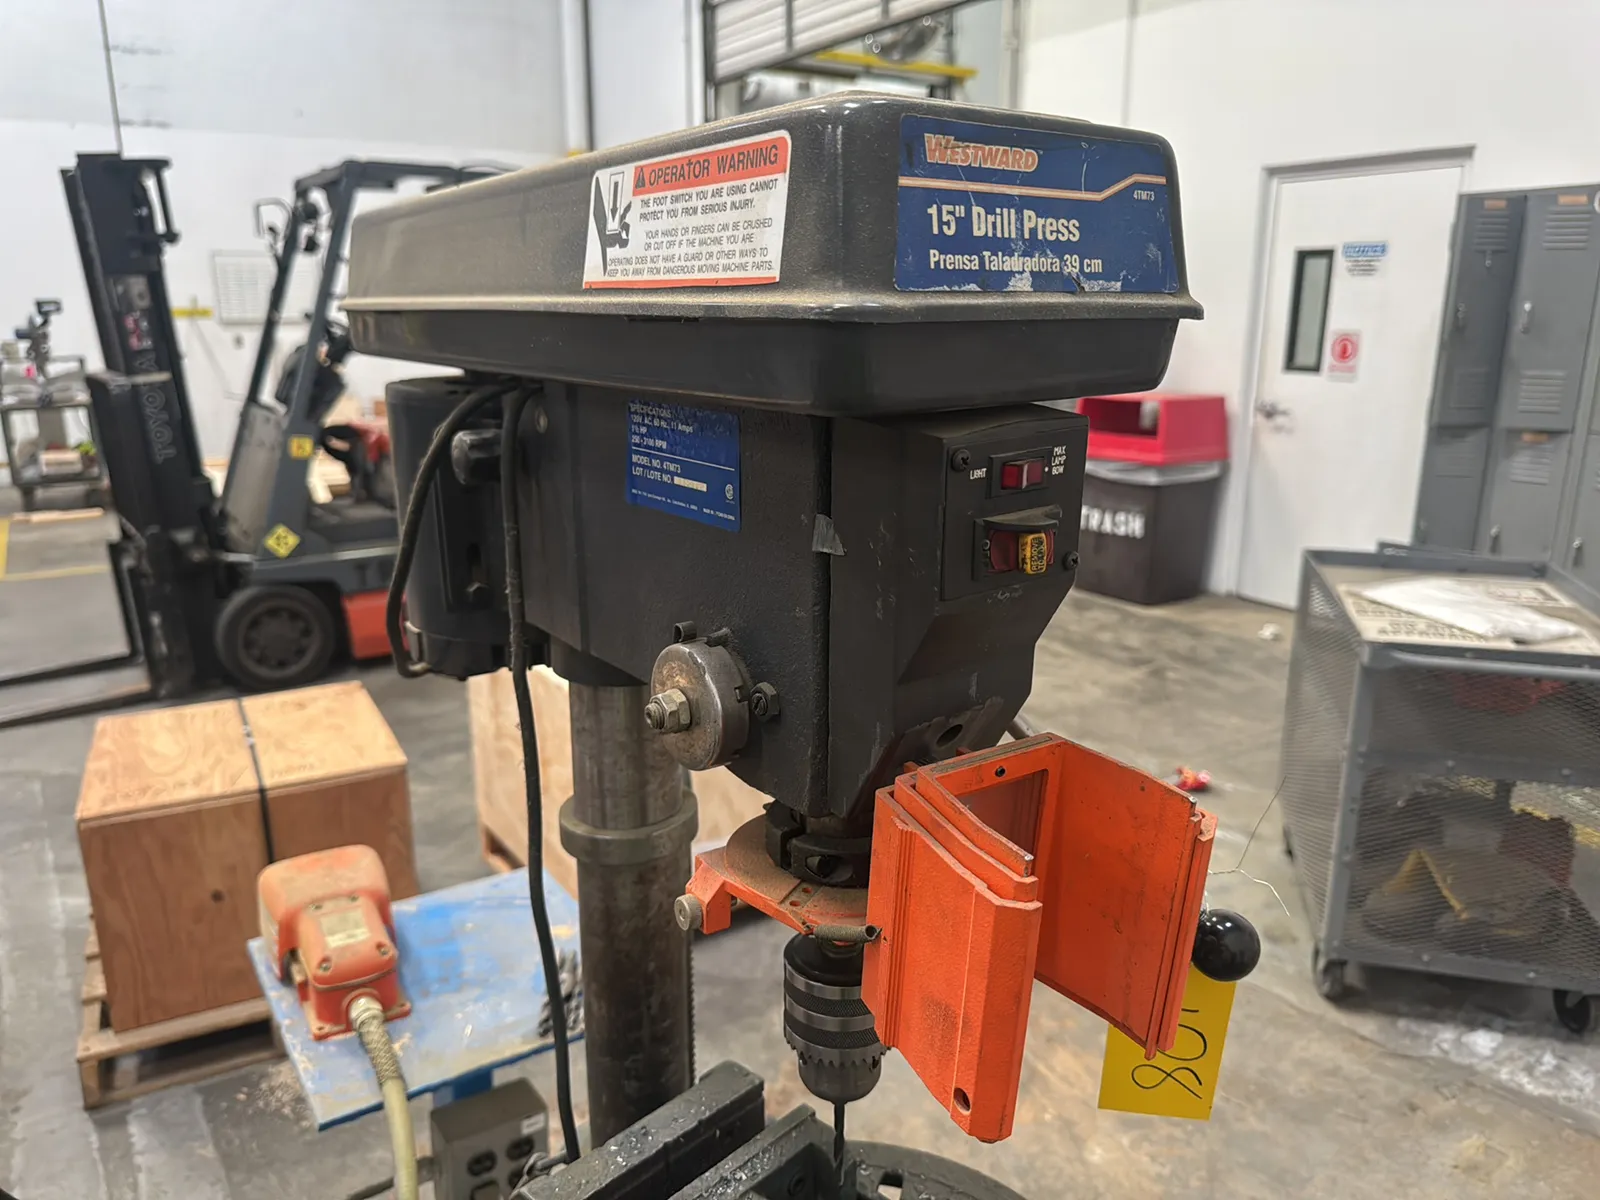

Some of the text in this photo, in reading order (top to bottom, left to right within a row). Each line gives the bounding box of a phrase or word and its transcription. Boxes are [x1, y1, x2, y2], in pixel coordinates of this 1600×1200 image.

[924, 133, 1038, 172] WESTWARD
[650, 145, 778, 186] OPERATOR WARNING
[641, 179, 778, 208] THE FOOT SWITCH YOU ARE USING CANNOT
[1133, 189, 1155, 201] 4TM73
[640, 199, 756, 222] PROTECT YOU FROM SERIOUS INJURY.
[646, 218, 772, 239] YOUR HANDS OR FINGERS CAN BE CRUSHED
[927, 204, 1080, 242] 15" Drill Press
[644, 234, 754, 251] OR CUT OFF IF THE MACHINE YOU ARE
[608, 256, 633, 267] OPERATING
[634, 256, 648, 265] DOES
[650, 255, 660, 263] NOT
[662, 254, 675, 263] HAVE
[684, 252, 703, 261] GUARD
[705, 251, 714, 260] OR
[716, 249, 736, 260] OTHER
[739, 248, 756, 258] WAYS
[758, 248, 768, 256] TO
[929, 249, 1102, 273] Prensa Taladradora 39 cm
[608, 260, 774, 277] KEEP YOU AWAY FROM DANGEROUS MOVING MACHINE PARTS.
[134, 352, 177, 464] TOYOA
[632, 454, 651, 466] MODEL
[1052, 456, 1066, 466] LAMP
[1054, 446, 1066, 455] MAX
[970, 468, 987, 479] LIGHT
[1080, 505, 1145, 539] TRASH
